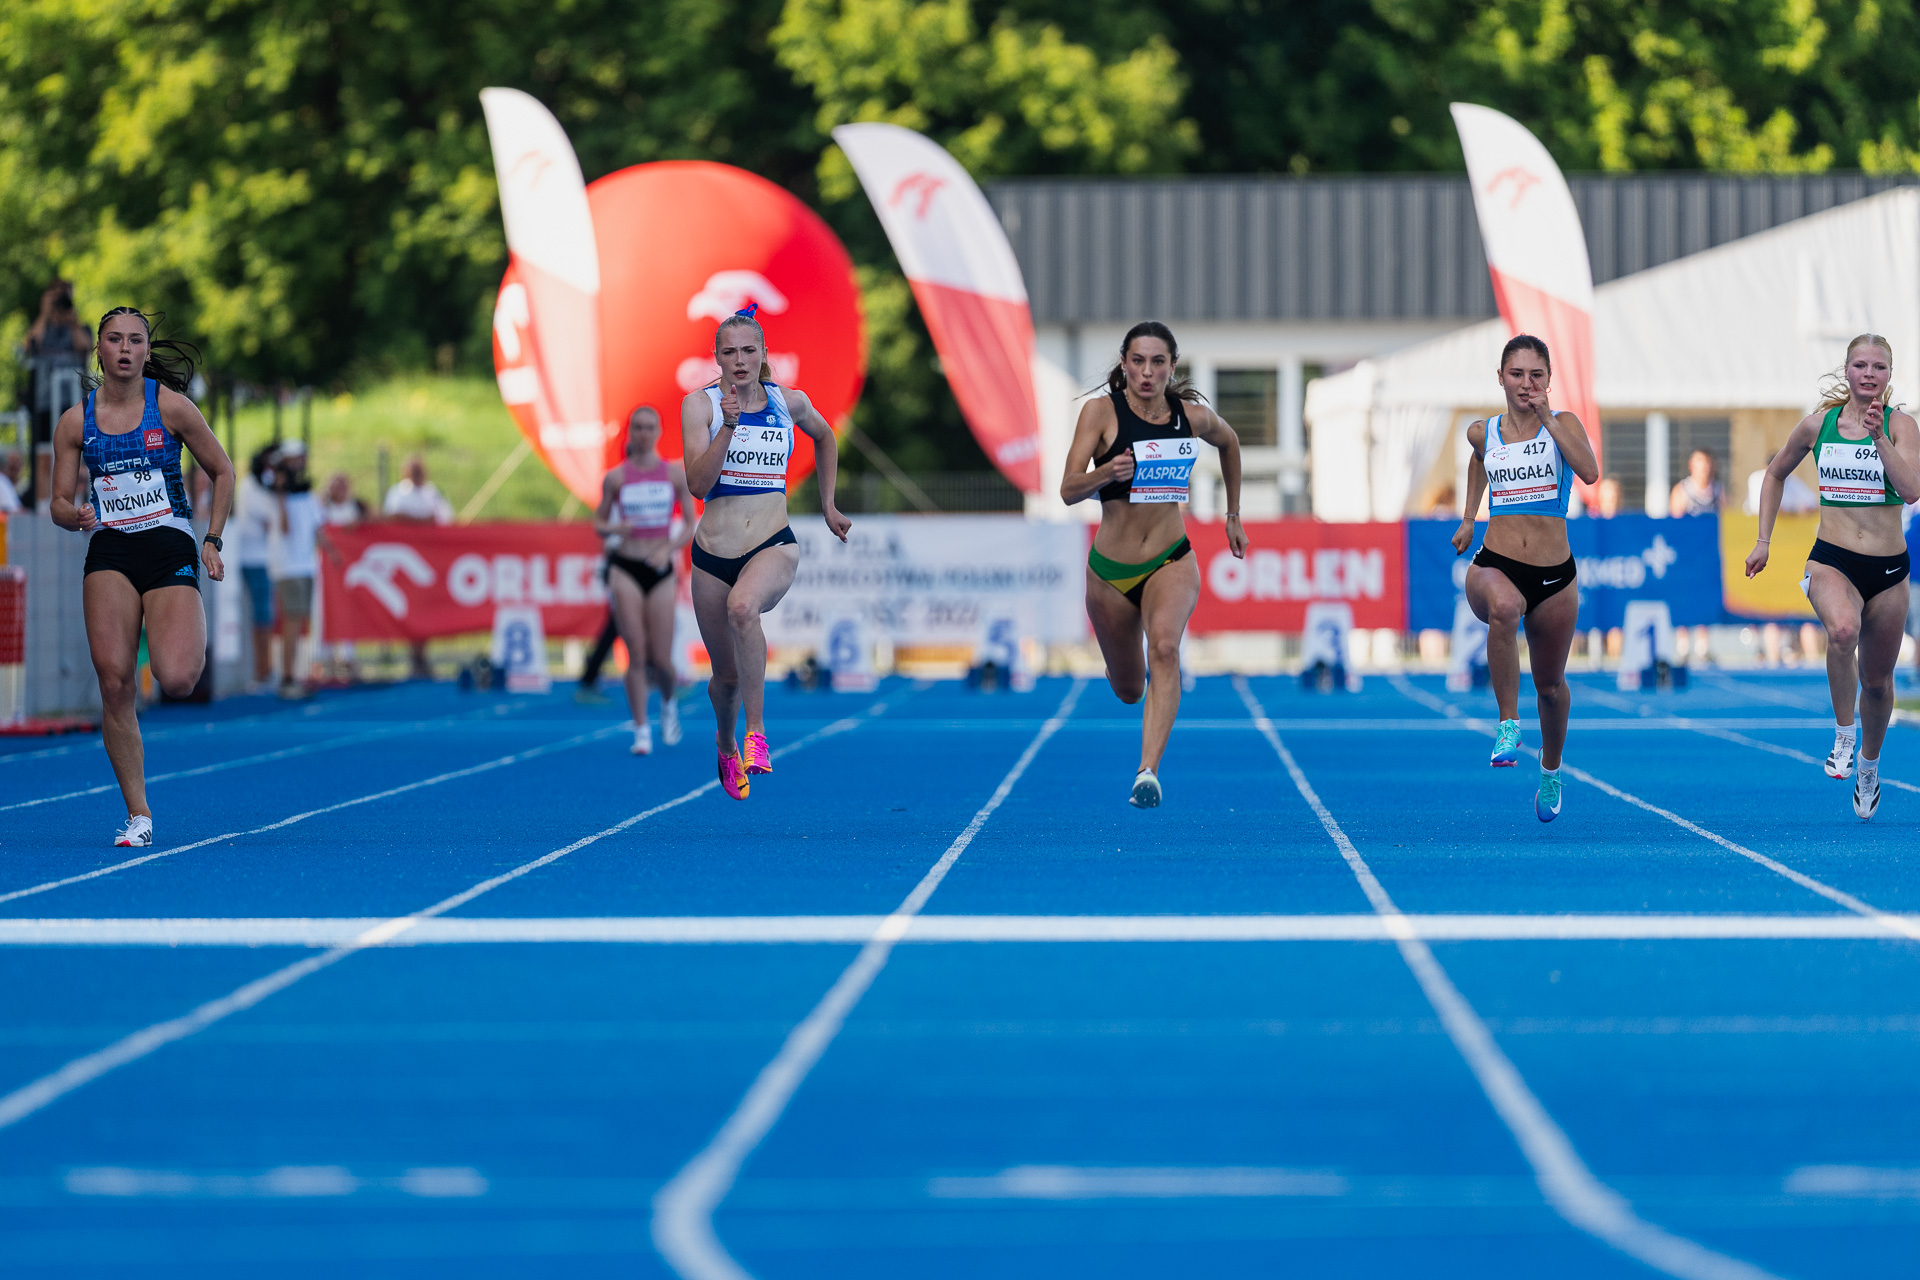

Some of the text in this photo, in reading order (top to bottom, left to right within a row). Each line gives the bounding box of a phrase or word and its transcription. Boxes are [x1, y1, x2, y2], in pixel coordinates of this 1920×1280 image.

[761, 430, 783, 443] 474
[1178, 442, 1192, 455] 65
[1523, 441, 1547, 456] 417
[1855, 448, 1878, 460] 694
[98, 457, 151, 473] VECTRA
[726, 450, 786, 466] KOPYŁEK
[134, 470, 152, 484] 98
[1488, 463, 1554, 484] MRUGAŁA
[1820, 466, 1882, 482] MALESZKA
[734, 478, 760, 486] ZAMOŚĆ
[102, 488, 164, 514] WOŹNIAK
[1502, 495, 1529, 503] ZAMOŚĆ
[144, 519, 160, 528] 2026
[1207, 548, 1384, 602] ORLEN
[503, 621, 532, 667] 8
[829, 619, 861, 666] 6
